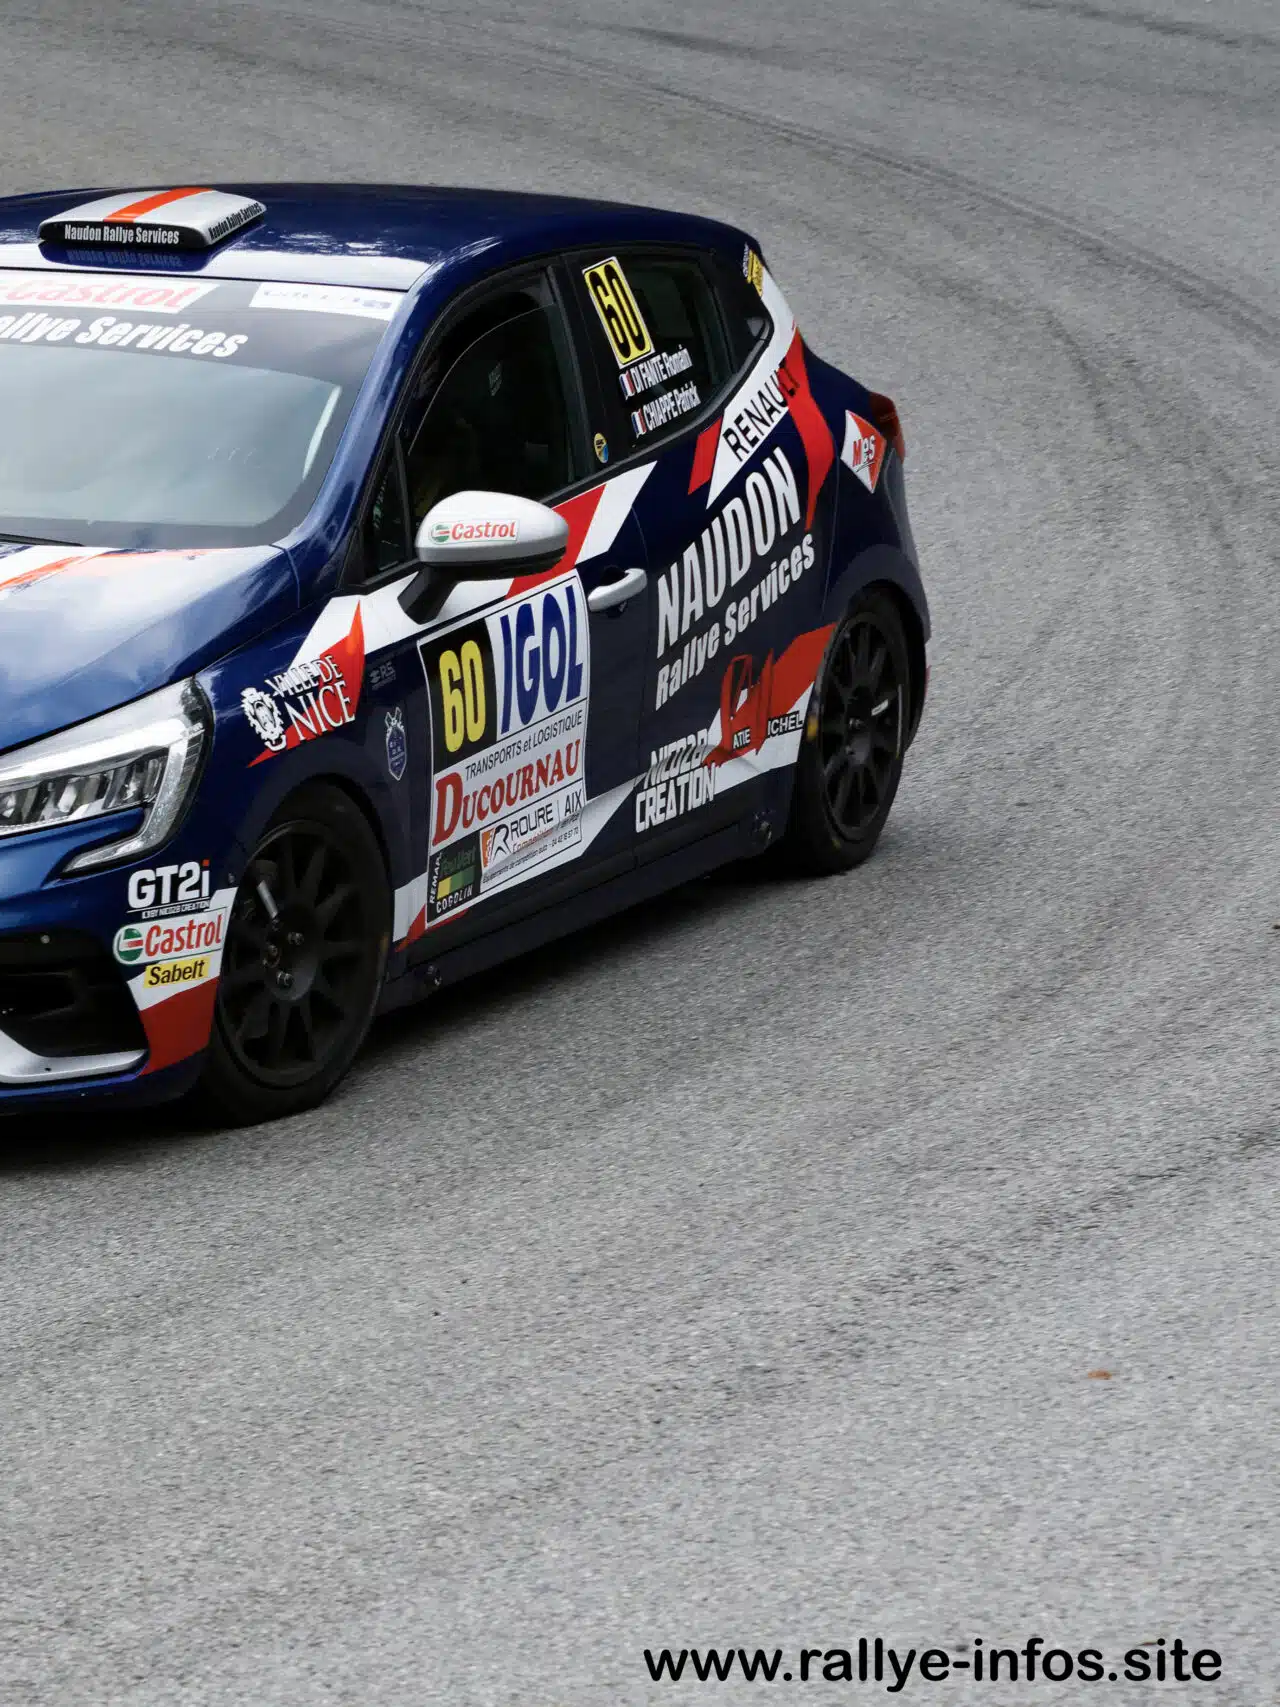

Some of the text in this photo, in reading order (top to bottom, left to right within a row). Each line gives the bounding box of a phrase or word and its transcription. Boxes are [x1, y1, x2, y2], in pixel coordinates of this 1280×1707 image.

[64, 224, 180, 245] Naudon Rallye Services
[6, 279, 199, 308] Castrol
[588, 264, 646, 359] 60
[75, 316, 248, 357] Services
[663, 344, 693, 380] Romain
[643, 390, 677, 431] CHIAPPE
[722, 357, 800, 462] RENAULT
[452, 522, 516, 540] Castrol
[657, 446, 800, 659] NAUDON
[264, 661, 322, 697] VILLE
[317, 655, 343, 683] DE
[500, 585, 583, 734] IGOL
[656, 622, 720, 712] Rallye
[284, 681, 355, 740] NICE
[439, 640, 486, 753] 60
[466, 710, 583, 781] TRANSPORTS et LOGISTIQUE
[432, 739, 580, 847] DUCOURNAU
[510, 803, 554, 840] ROURE
[564, 789, 583, 817] AIX
[636, 762, 716, 833] CREATION
[128, 860, 210, 908] GT2i
[436, 886, 473, 914] COGOLIN
[145, 914, 222, 956] Castrol
[148, 960, 204, 986] Sabelt
